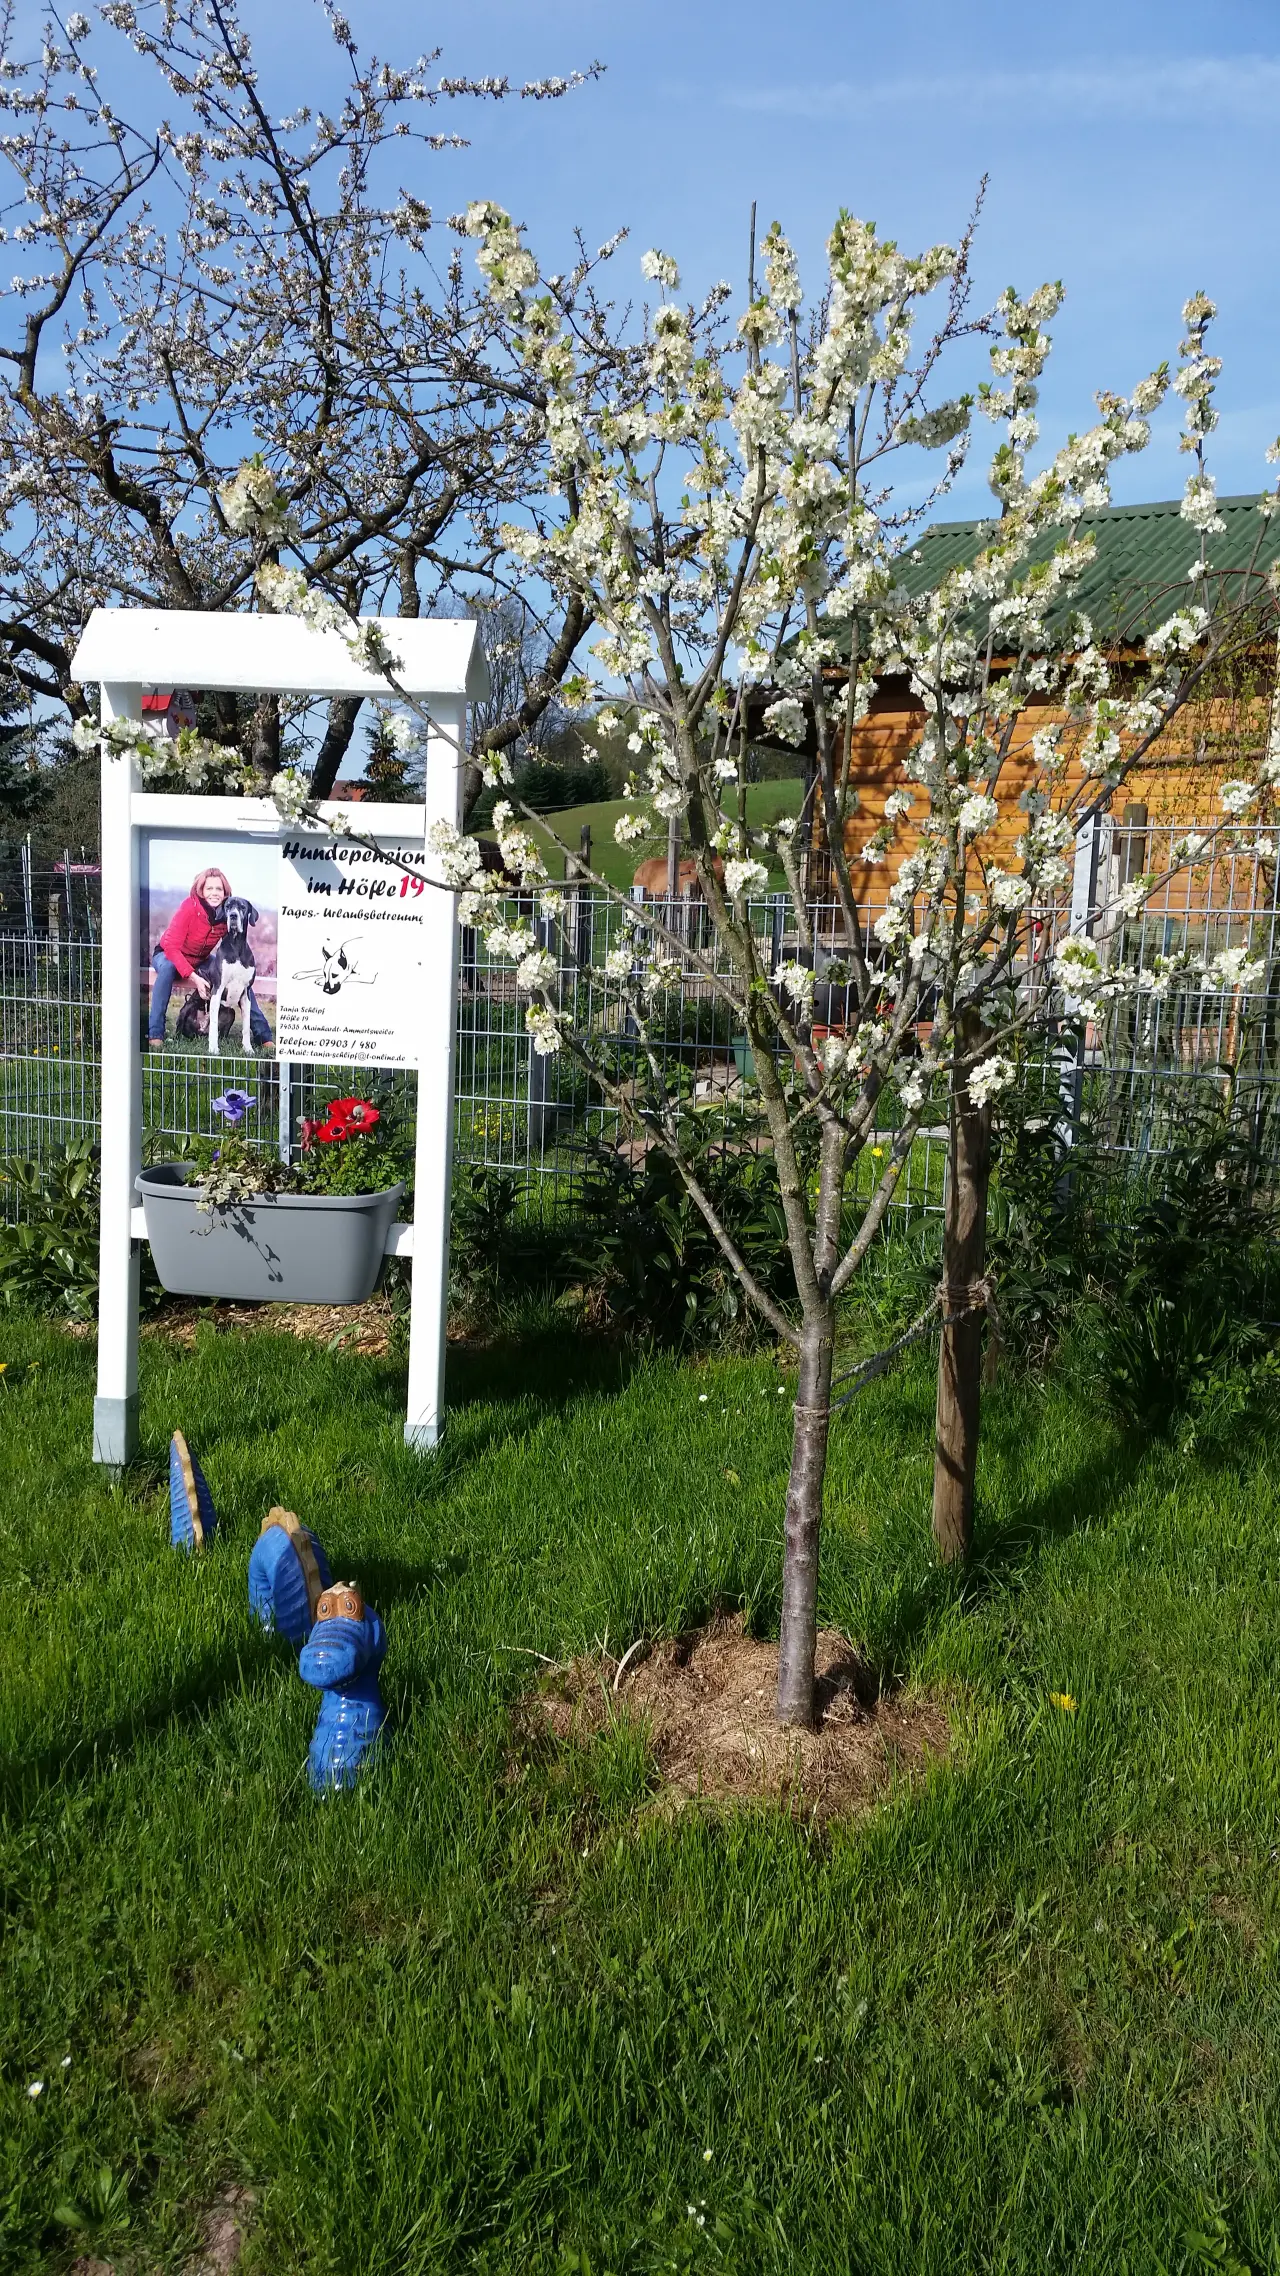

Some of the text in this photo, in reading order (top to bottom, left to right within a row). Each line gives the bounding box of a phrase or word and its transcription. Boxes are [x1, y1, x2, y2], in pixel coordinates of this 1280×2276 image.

[282, 842, 425, 865] Hundepension
[307, 875, 425, 900] im Höfle 19
[280, 1005, 326, 1016] Tanja Schlipf
[280, 1014, 300, 1022] Höfle
[279, 1036, 318, 1048] Telefon:
[319, 1038, 348, 1049] 07903
[360, 1041, 377, 1050] 480
[278, 1048, 310, 1057] E-Mail:
